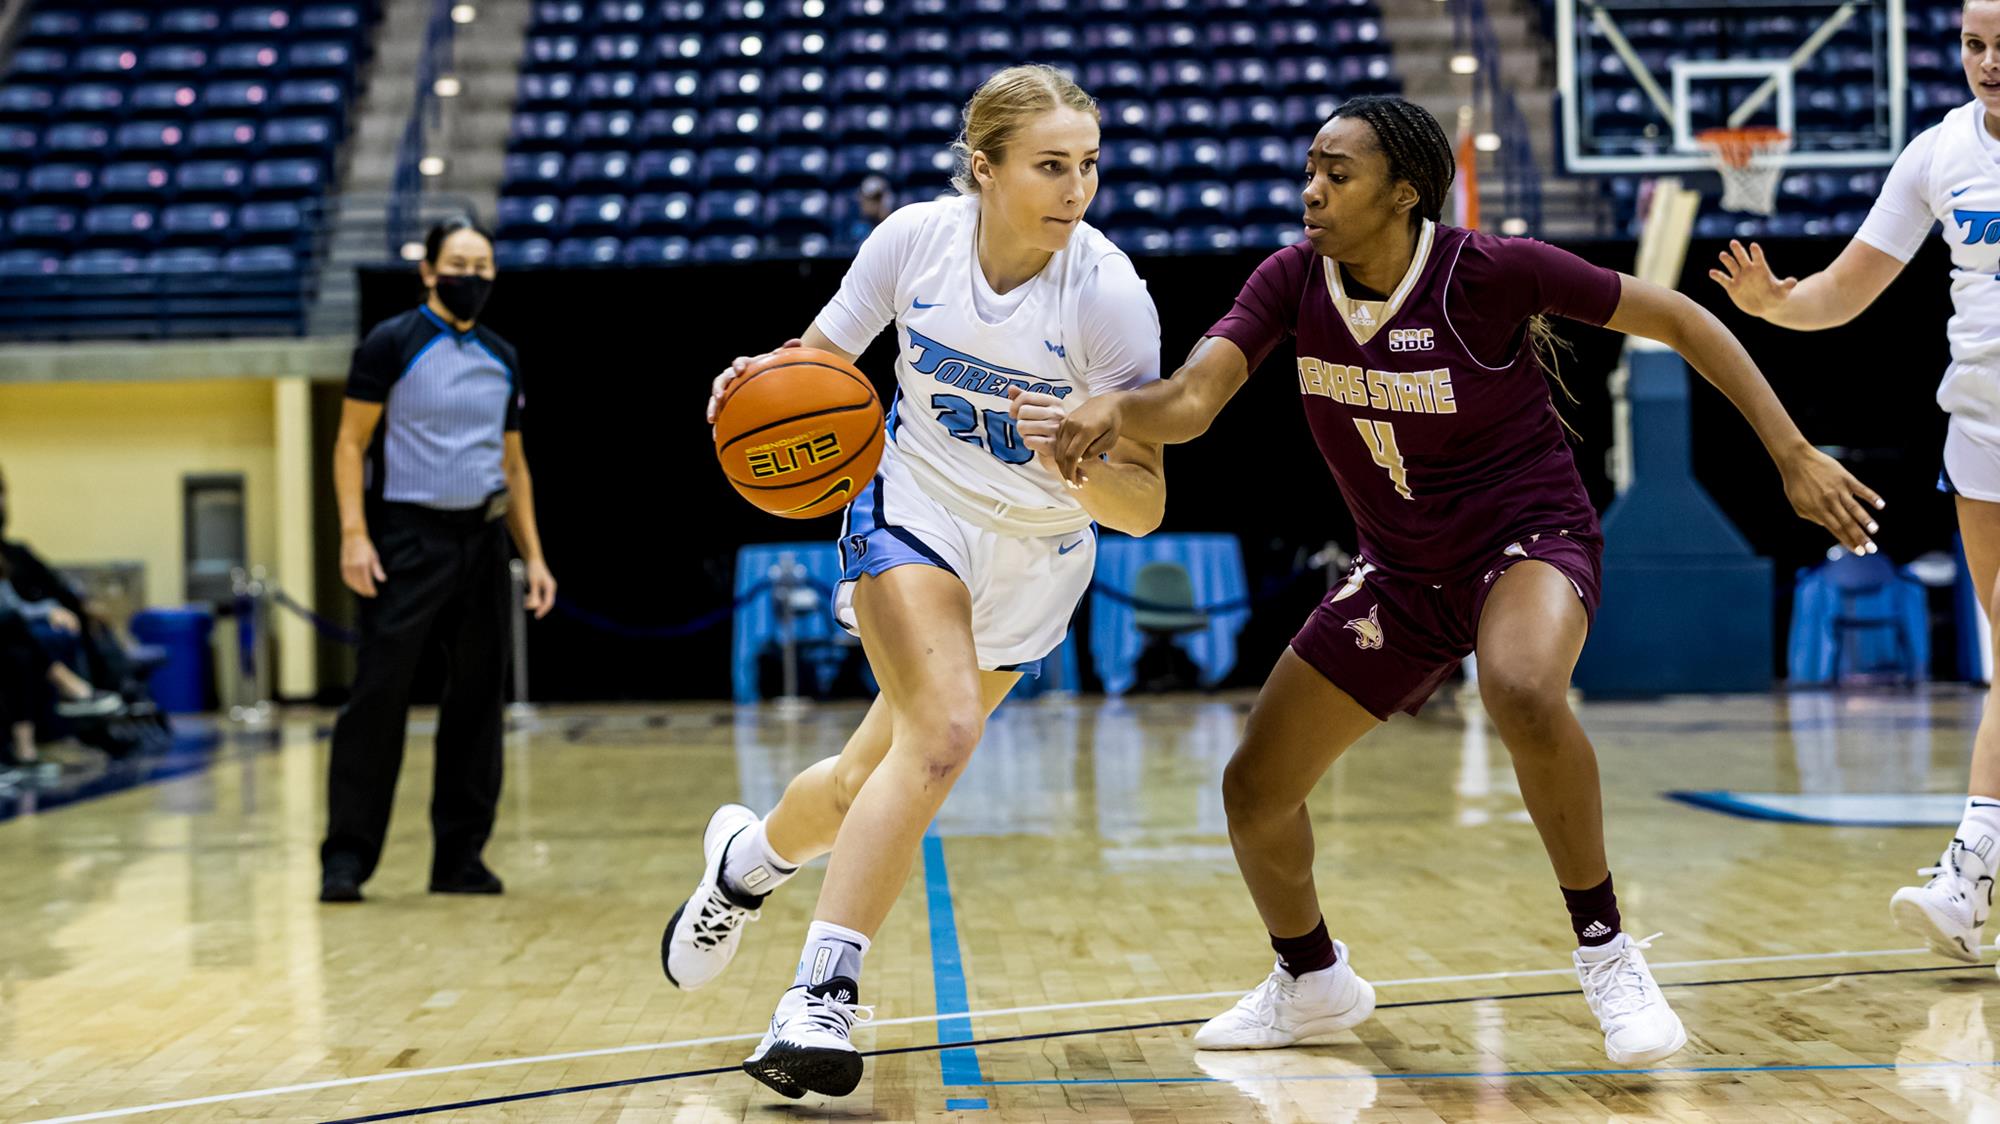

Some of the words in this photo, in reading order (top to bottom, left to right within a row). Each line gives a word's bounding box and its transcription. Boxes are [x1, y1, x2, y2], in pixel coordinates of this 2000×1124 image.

[1389, 328, 1434, 352] SBC
[1366, 367, 1457, 414] STATE
[931, 394, 1035, 465] 20
[745, 430, 843, 480] ELITE
[1352, 417, 1415, 501] 4
